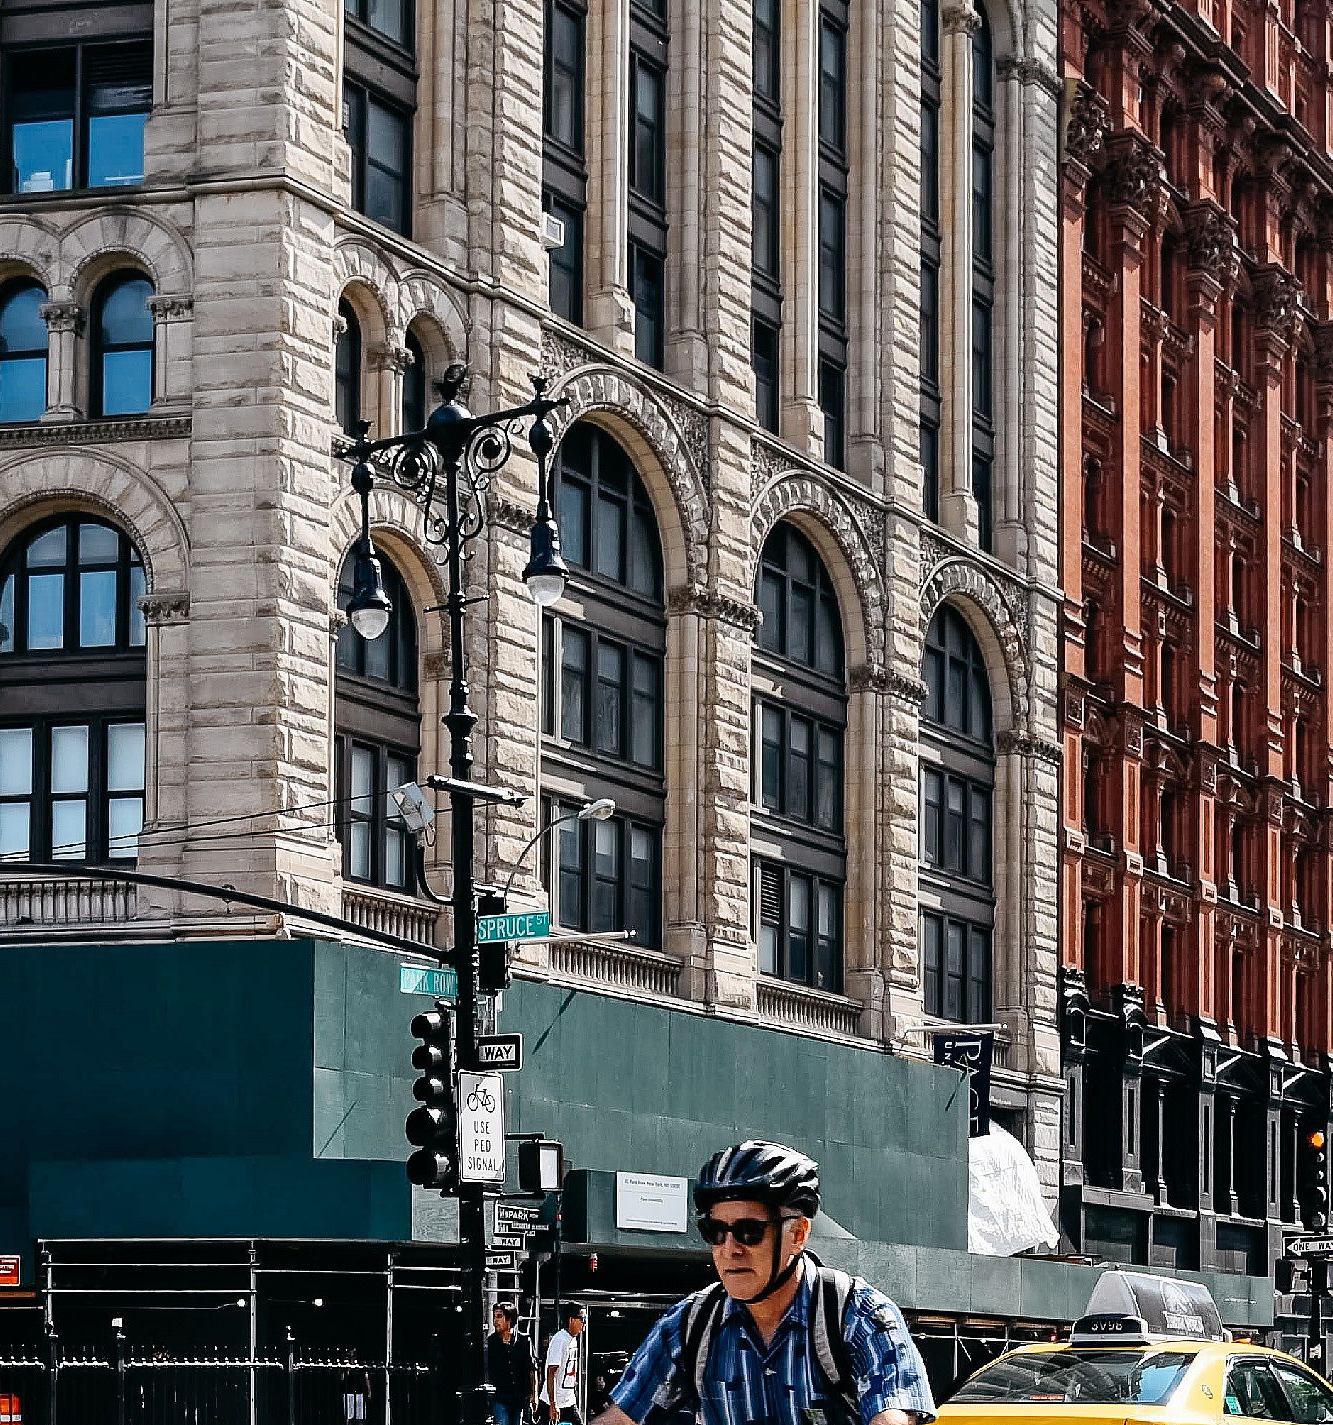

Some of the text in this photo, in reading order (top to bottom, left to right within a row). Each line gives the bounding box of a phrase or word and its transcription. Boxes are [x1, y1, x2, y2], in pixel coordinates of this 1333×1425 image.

[478, 913, 548, 941] SPRUCE ST
[433, 971, 455, 995] ROW
[484, 1045, 513, 1061] WAY
[473, 1120, 490, 1135] USE
[474, 1138, 492, 1153] PED
[468, 1156, 499, 1172] SIGNAL
[1293, 1242, 1310, 1252] ONE
[1091, 1320, 1123, 1332] 3V98
